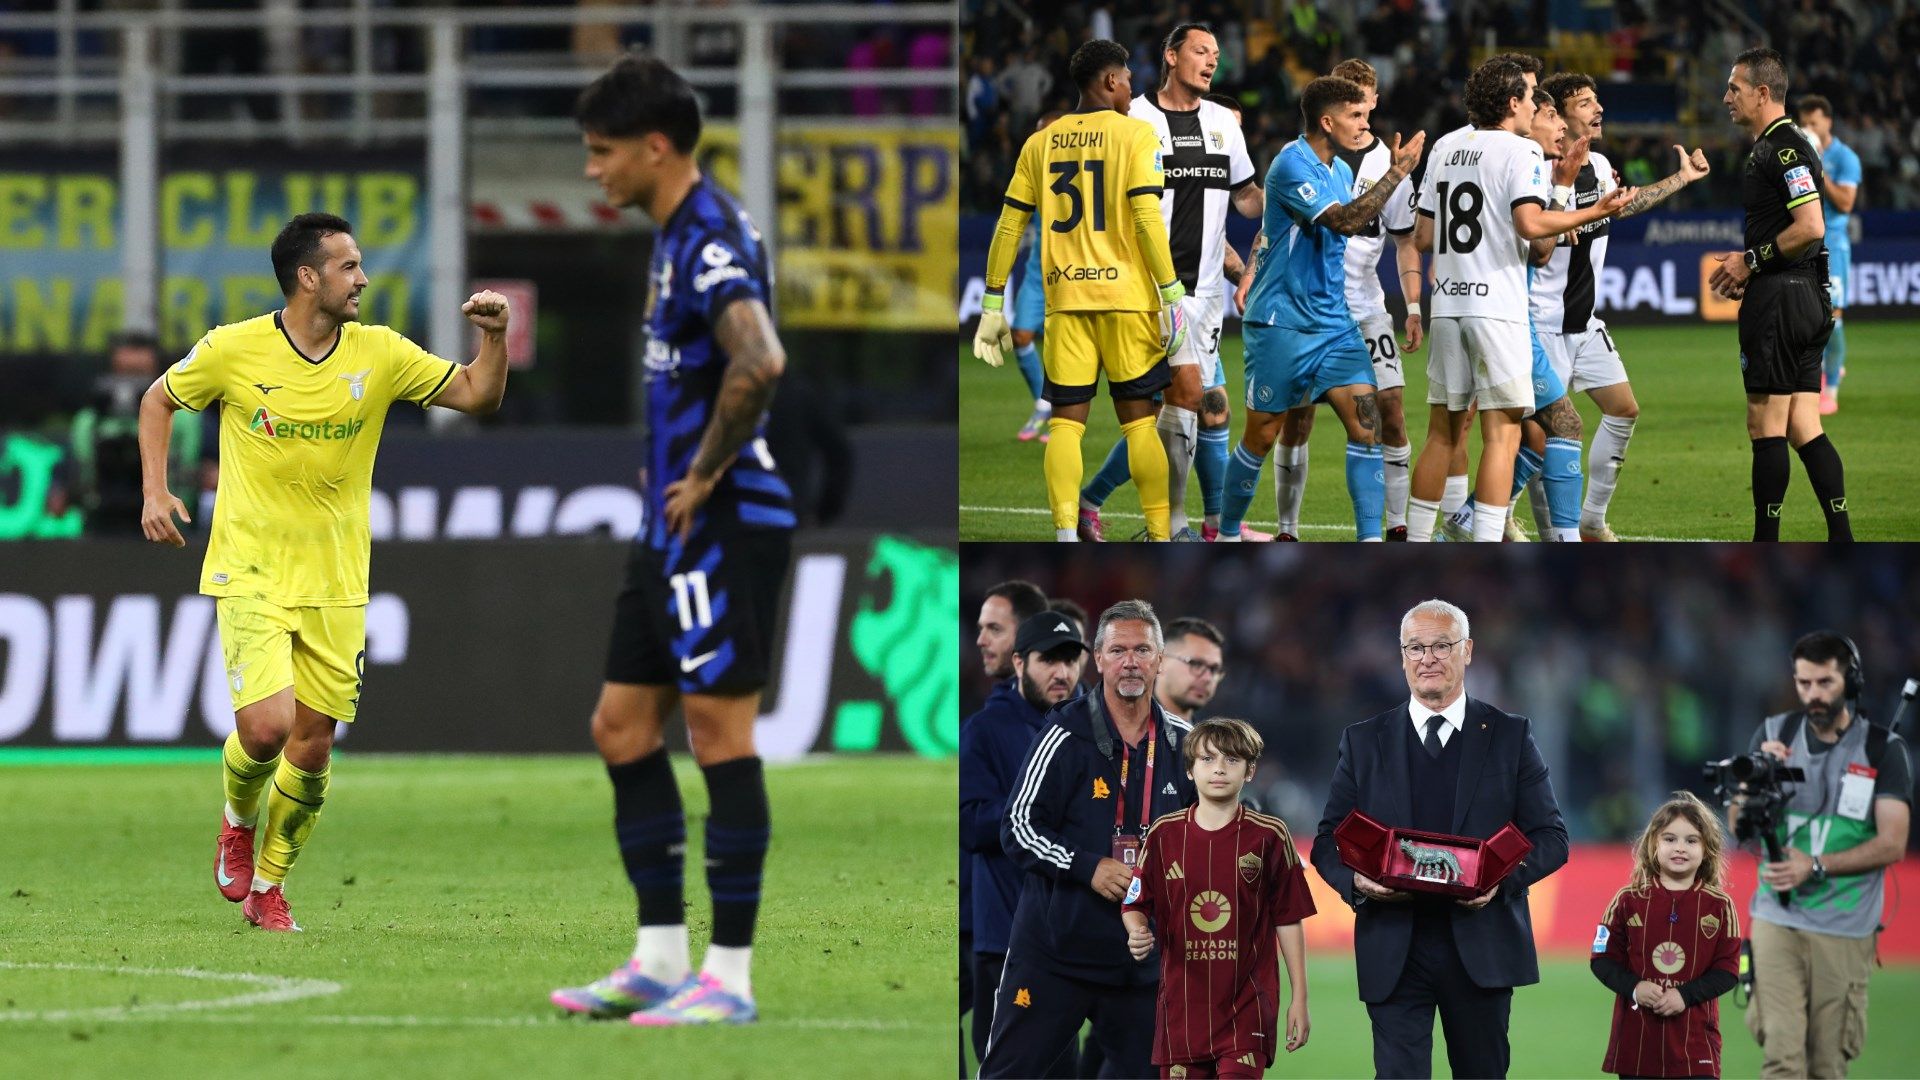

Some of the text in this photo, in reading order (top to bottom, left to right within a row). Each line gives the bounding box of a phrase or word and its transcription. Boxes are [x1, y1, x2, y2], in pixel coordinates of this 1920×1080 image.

[1051, 132, 1104, 150] SUZUKI
[1444, 150, 1483, 167] LØVIK
[1163, 166, 1228, 179] ROMETEON
[162, 171, 415, 249] CLUB
[1049, 159, 1106, 234] 31
[1436, 181, 1484, 255] 18
[1597, 261, 1697, 316] RAL
[670, 570, 713, 632] 11
[1185, 940, 1237, 950] RIYADH
[1185, 950, 1237, 961] SEASON
